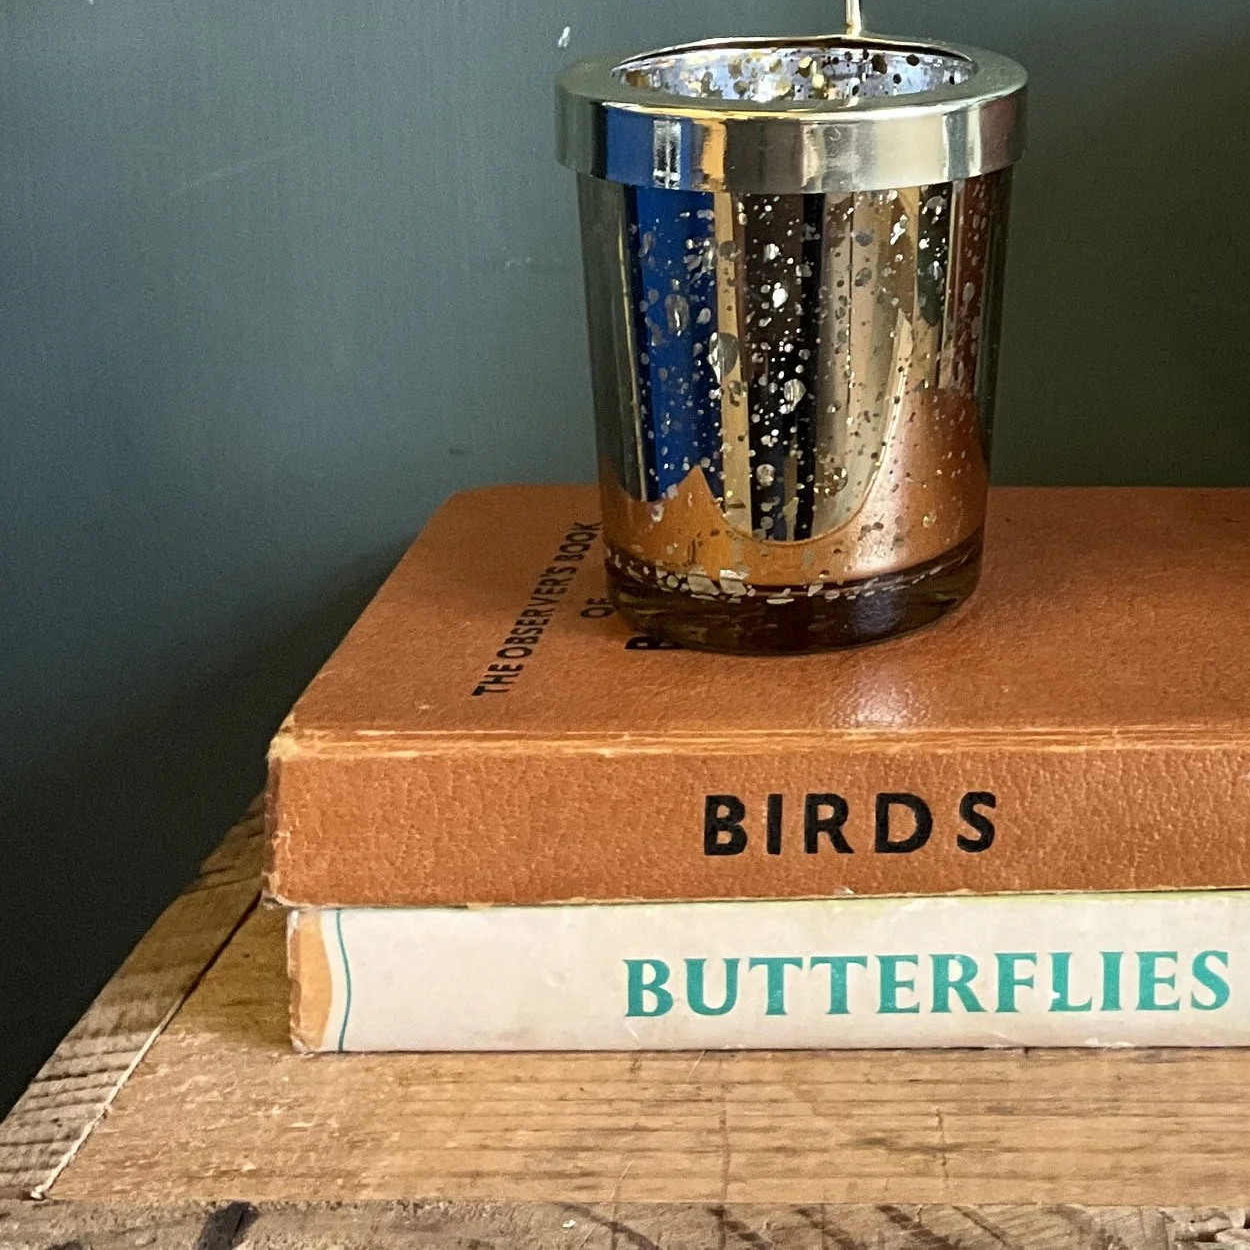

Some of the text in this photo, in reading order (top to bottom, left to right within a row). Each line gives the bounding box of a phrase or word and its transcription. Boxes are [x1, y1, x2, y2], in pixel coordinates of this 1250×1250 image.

[471, 521, 603, 697] THE OBSERVER'S BOOK
[703, 791, 997, 856] BIRDS
[623, 951, 1230, 1018] BUTTERFLIES
